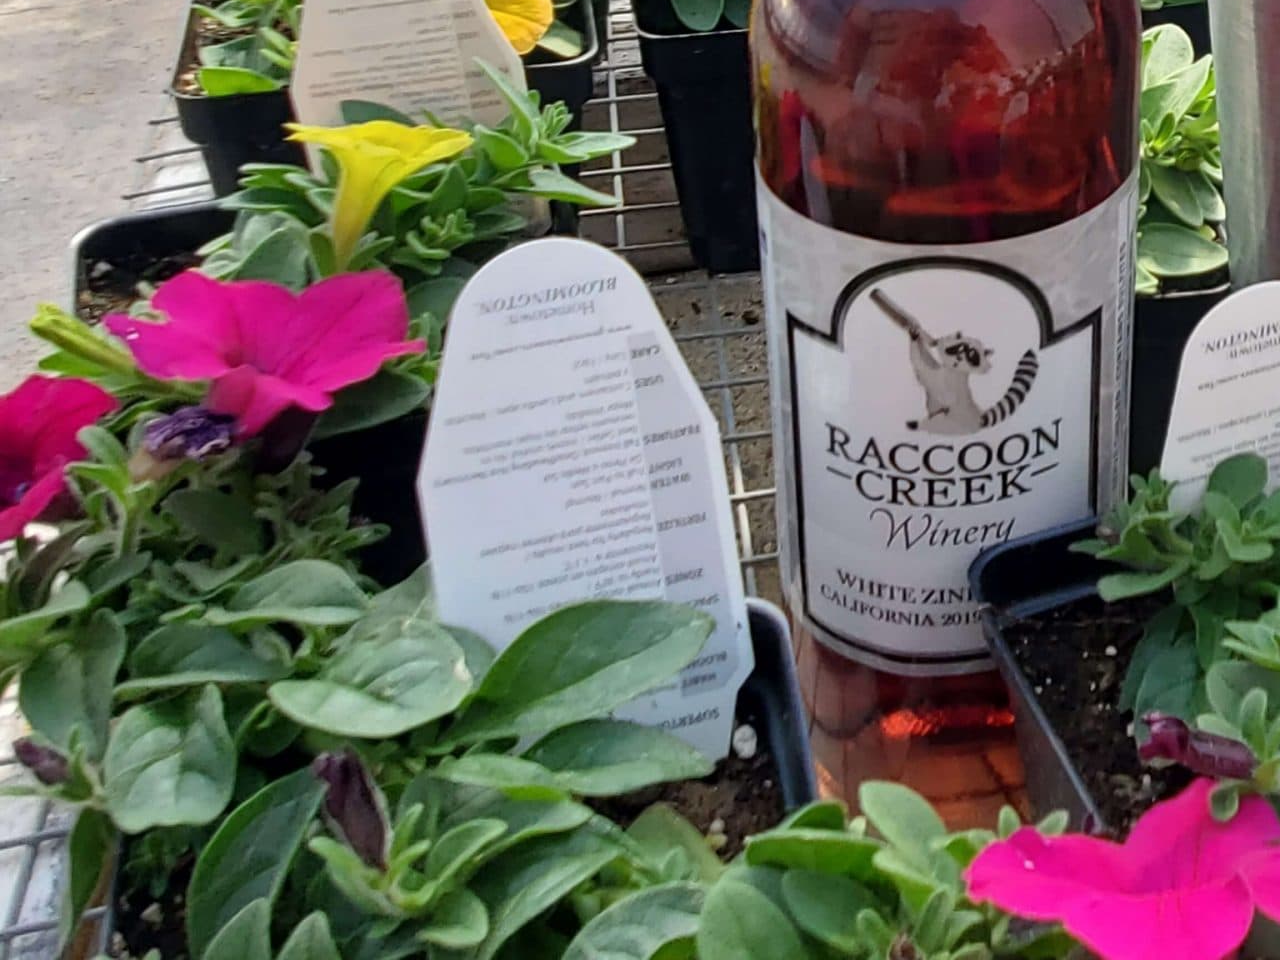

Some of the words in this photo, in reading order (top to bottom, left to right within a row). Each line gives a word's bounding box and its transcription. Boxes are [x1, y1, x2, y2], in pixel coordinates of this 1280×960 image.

[629, 343, 660, 360] CARE
[634, 373, 663, 390] USES
[642, 422, 699, 445] FEATURES
[824, 417, 1063, 475] RACCOON
[648, 456, 682, 475] LIGHT
[650, 470, 690, 490] WATER
[854, 464, 1034, 508] CREEK
[870, 507, 1017, 552] Winery
[664, 566, 703, 586] ZONES
[837, 569, 917, 603] WHITE
[820, 584, 934, 626] CALIFORNIA
